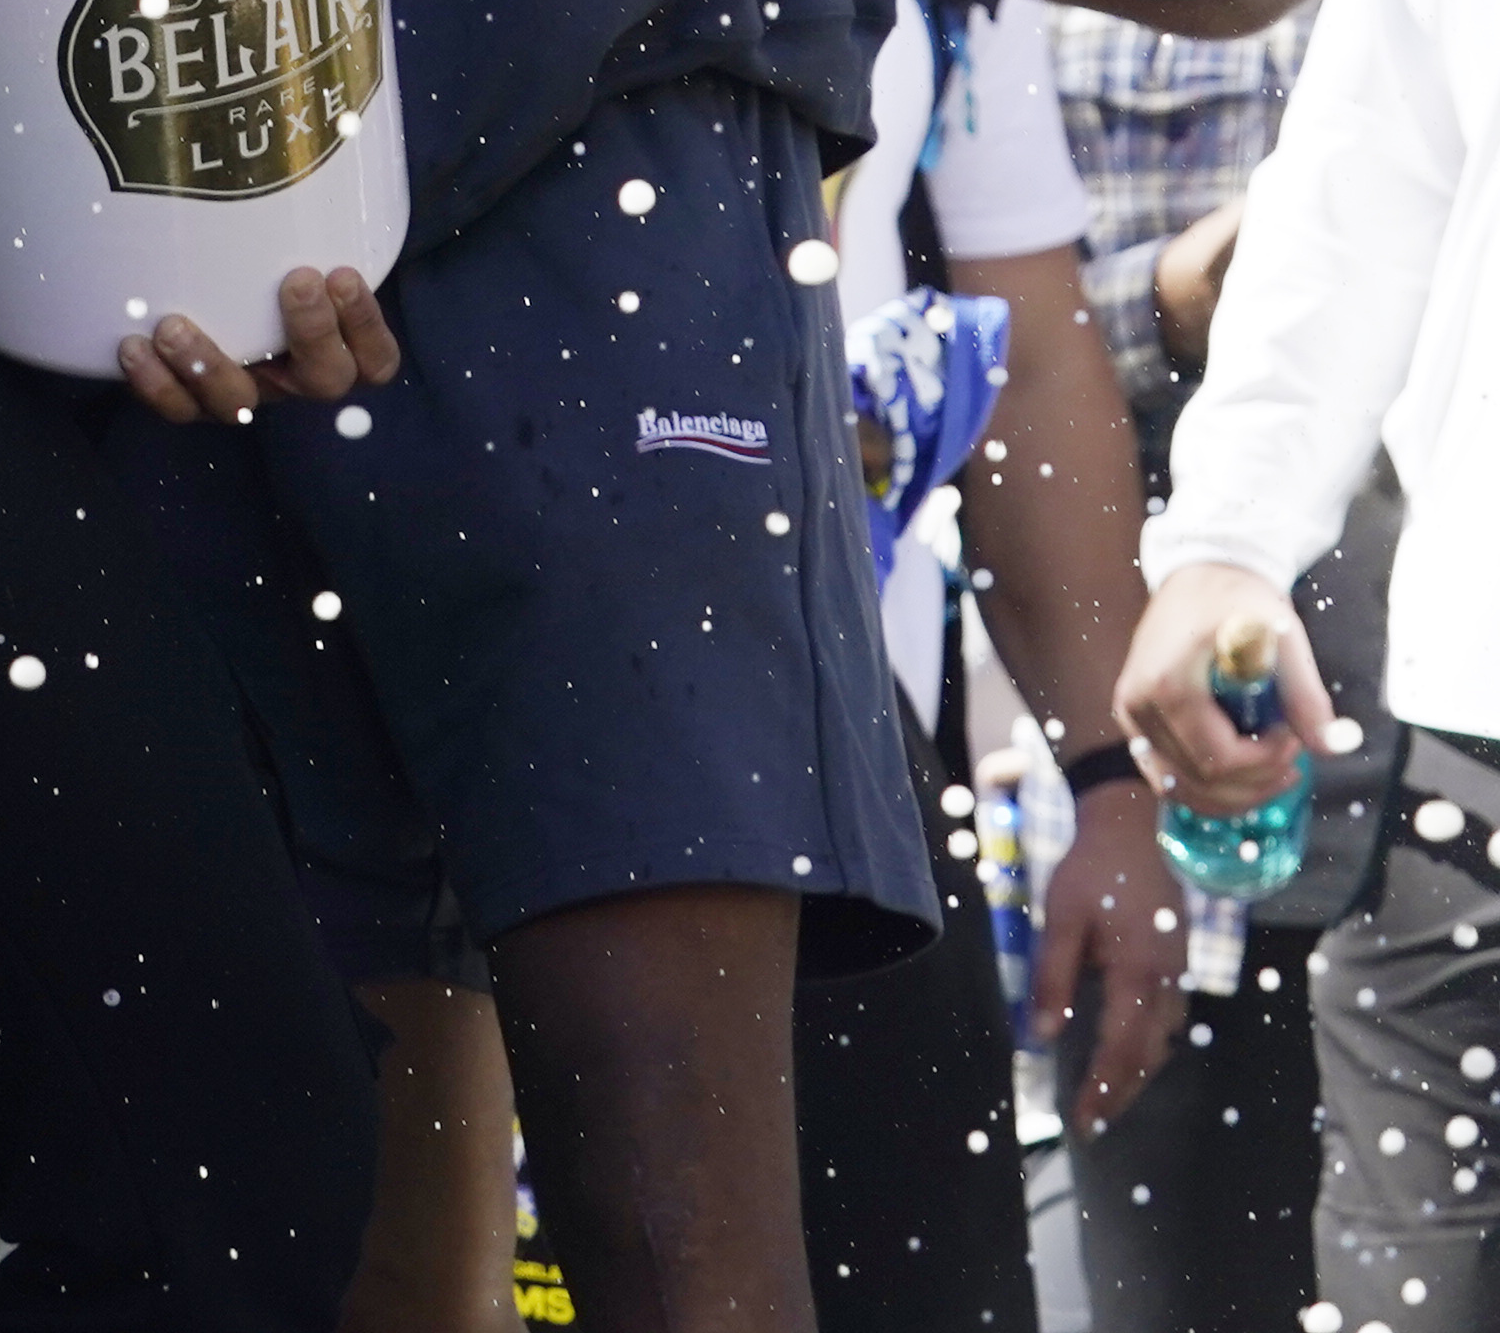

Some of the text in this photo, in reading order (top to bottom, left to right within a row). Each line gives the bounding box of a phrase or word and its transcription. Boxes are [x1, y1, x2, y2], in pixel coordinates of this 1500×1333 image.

[228, 74, 319, 125] RARE
[190, 83, 350, 172] LUXE
[636, 408, 768, 442] Balenciaga
